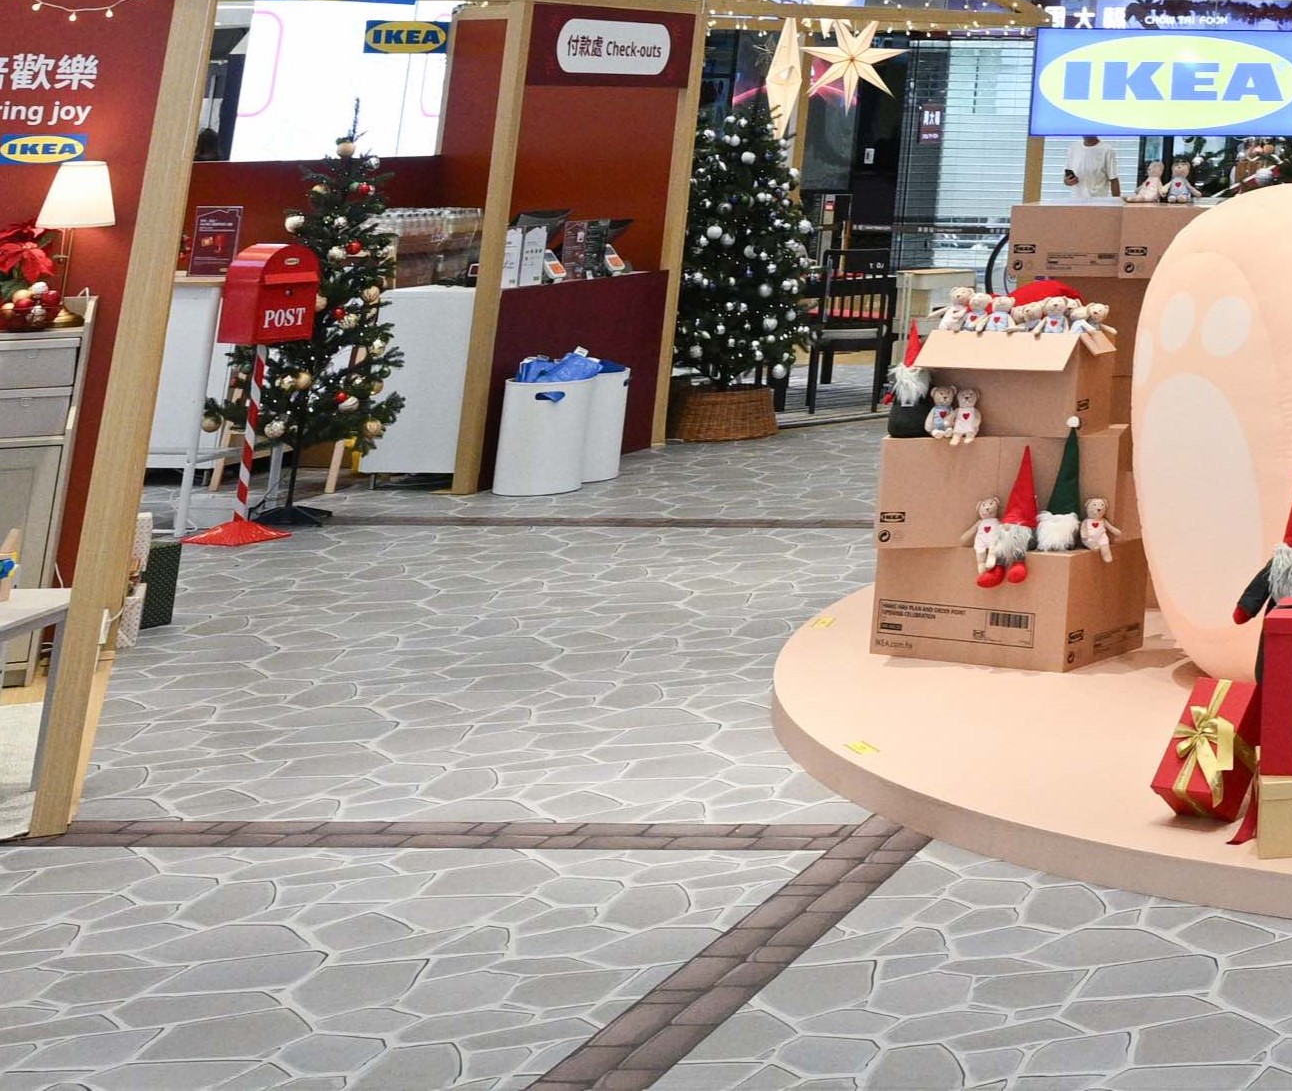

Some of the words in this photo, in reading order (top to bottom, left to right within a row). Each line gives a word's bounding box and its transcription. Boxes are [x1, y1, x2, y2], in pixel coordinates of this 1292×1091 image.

[372, 30, 440, 44] IKEA
[567, 34, 604, 58] 付款處
[606, 41, 661, 58] Check-outs
[1063, 61, 1284, 101] IKEA
[0, 101, 44, 125] ing
[47, 101, 92, 125] joy
[7, 143, 77, 155] IKEA
[263, 307, 306, 329] POST
